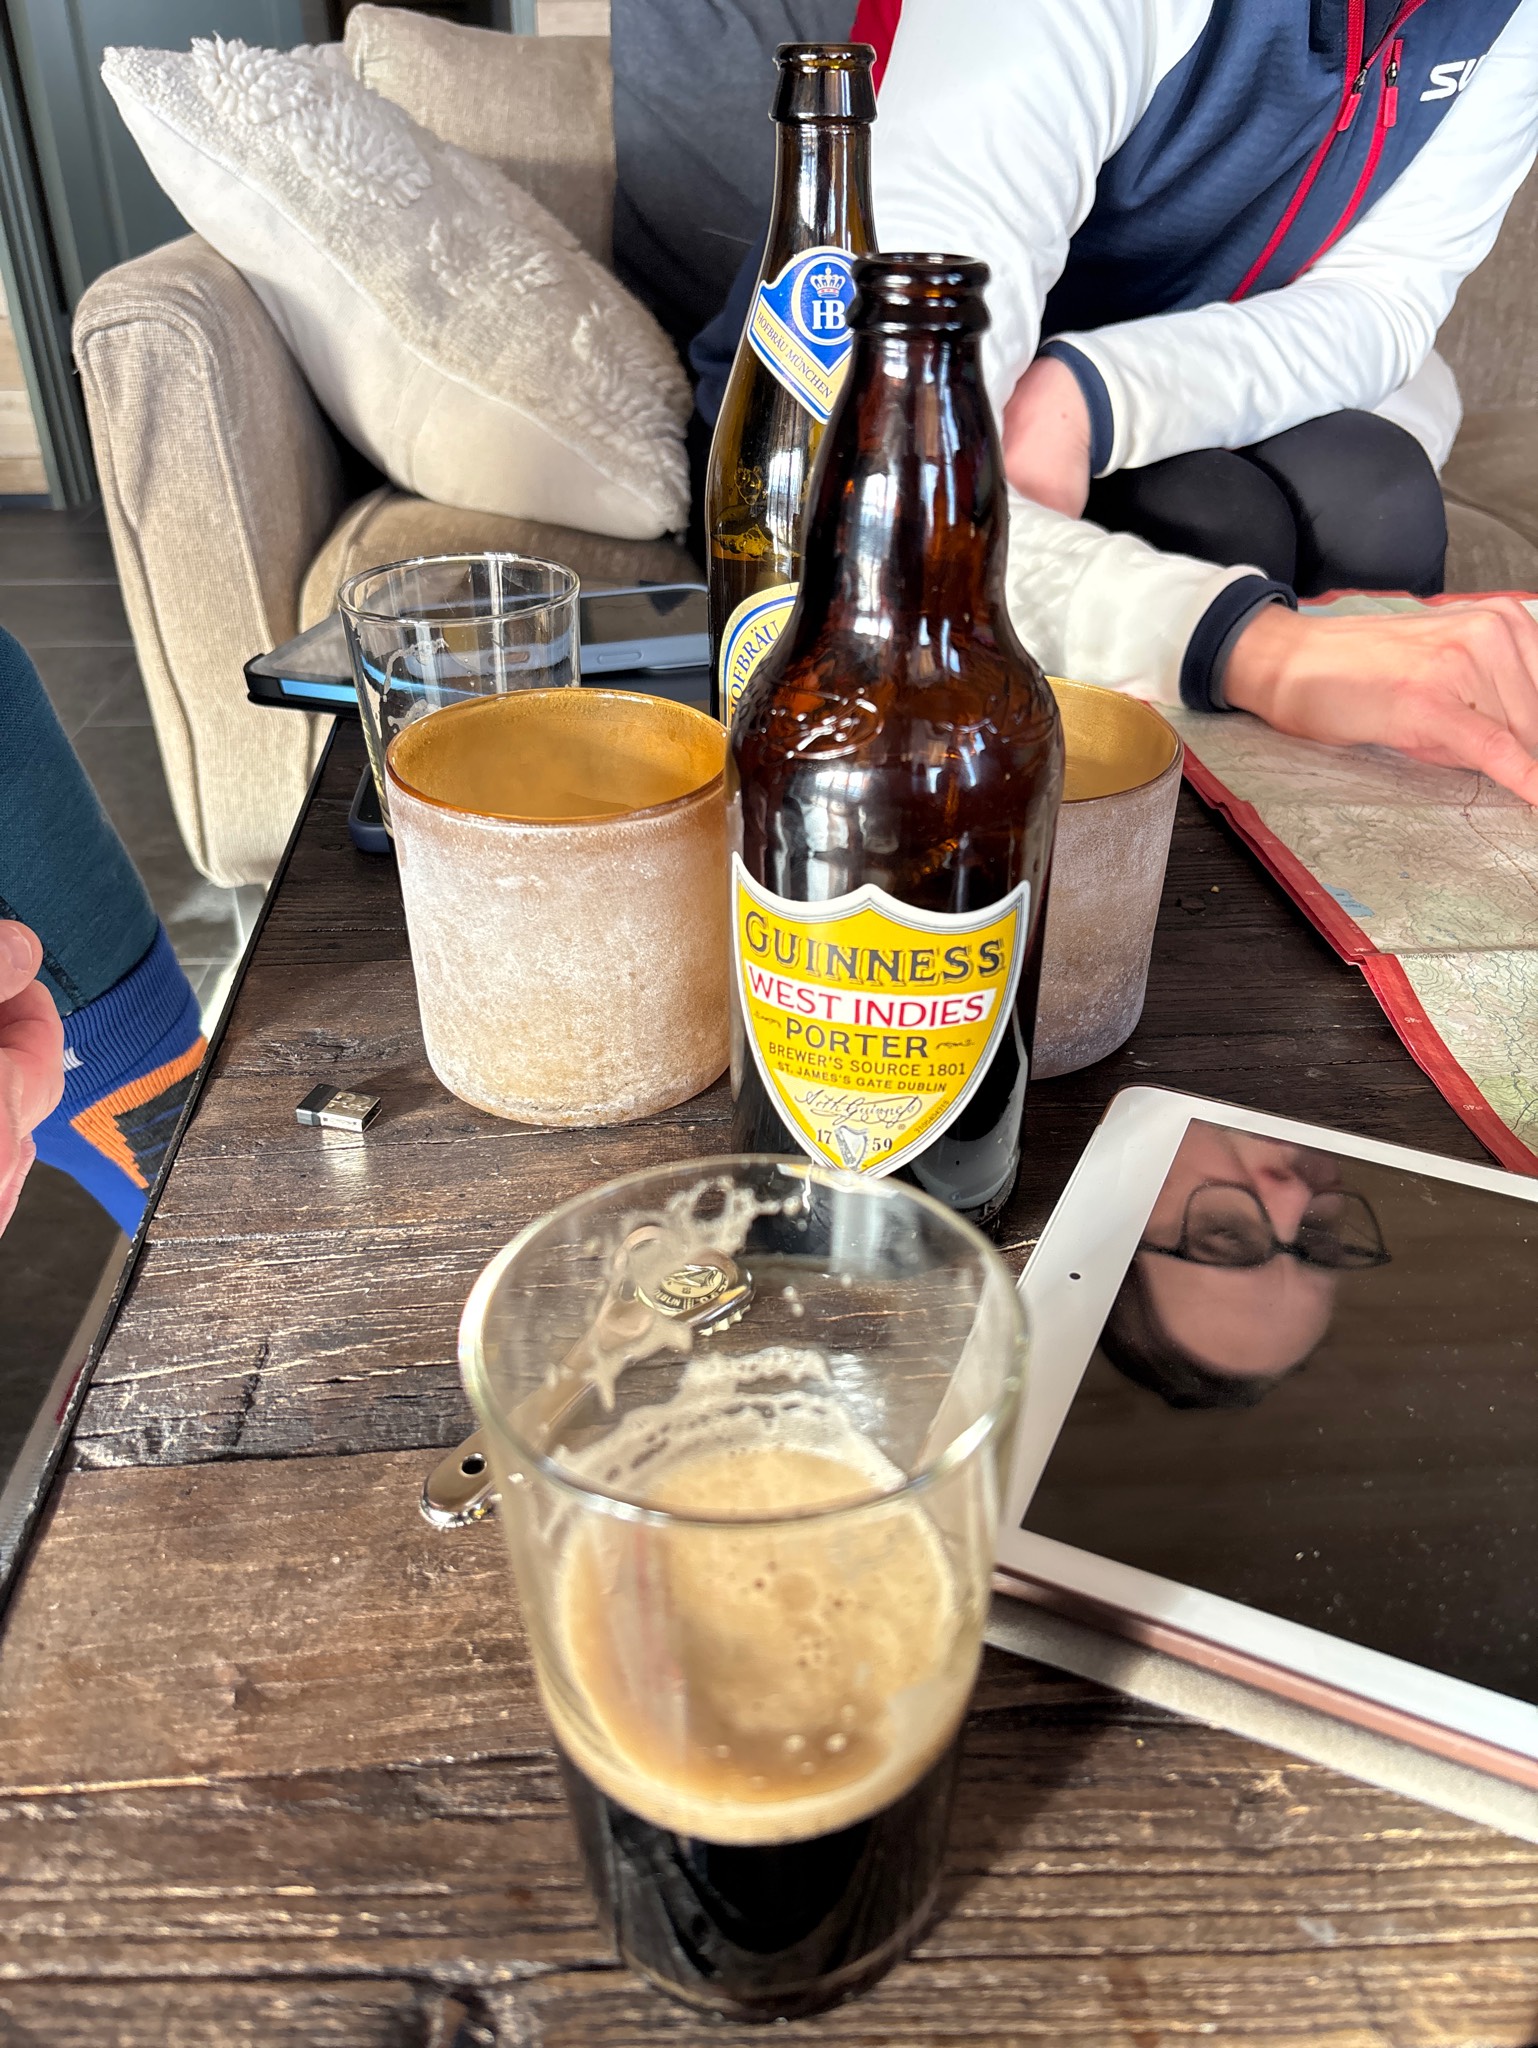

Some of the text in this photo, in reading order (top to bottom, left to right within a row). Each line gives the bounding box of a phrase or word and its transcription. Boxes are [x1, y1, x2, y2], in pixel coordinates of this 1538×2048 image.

[811, 299, 846, 330] HB
[757, 311, 833, 398] HOFBRÄU MÜNCHEN
[745, 910, 1005, 987] GUINNESS
[749, 965, 984, 1028] WEST INDIES
[786, 1016, 928, 1058] PORTER
[769, 1041, 965, 1077] BREWER'S SOURCE 1801
[777, 1061, 947, 1093] ST. JAMES'S GATE DUBLIN
[817, 1129, 832, 1145] 17
[872, 1137, 893, 1153] 59
